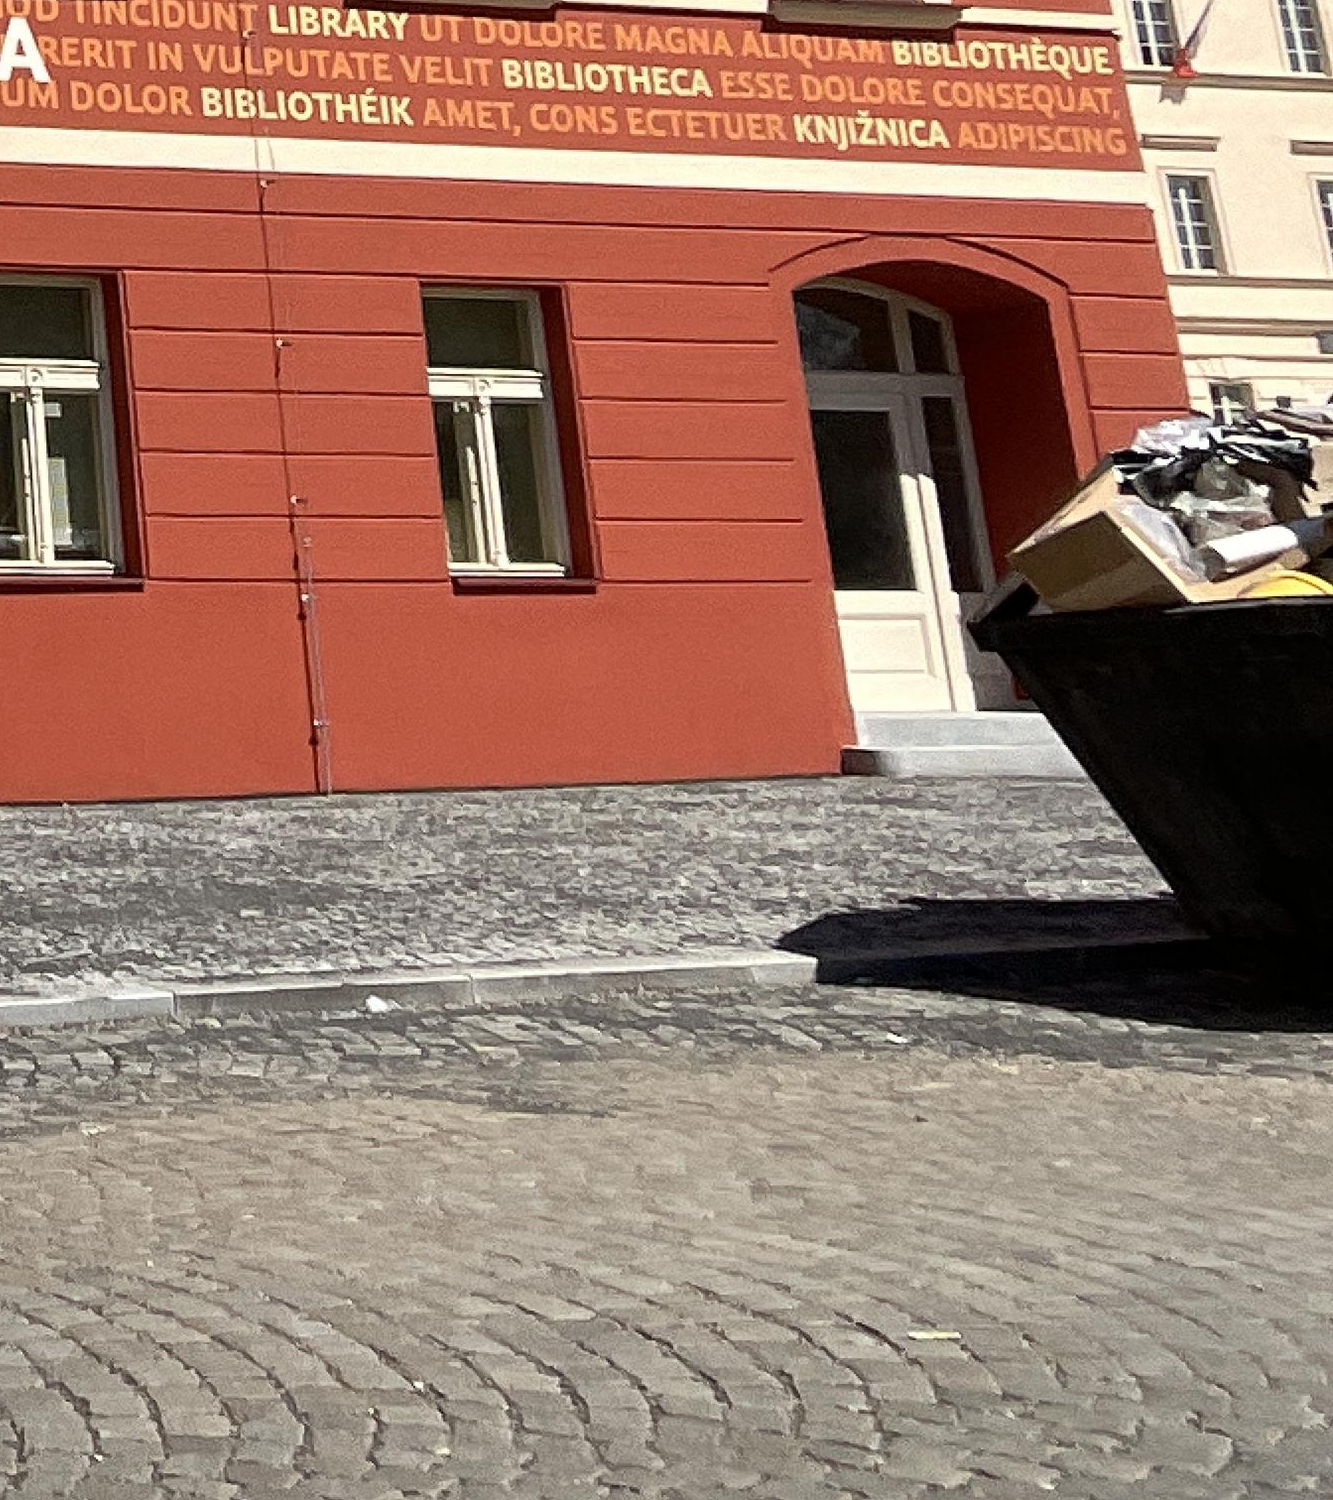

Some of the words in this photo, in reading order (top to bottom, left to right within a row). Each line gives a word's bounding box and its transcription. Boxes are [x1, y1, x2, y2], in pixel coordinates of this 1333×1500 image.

[148, 42, 183, 72] IN
[194, 45, 392, 82] VULPUTATE
[396, 55, 494, 86] VELIT
[501, 58, 713, 98] BIBLIOTHECA
[721, 71, 792, 100] ESSE
[800, 75, 926, 106] DOLORE
[933, 80, 1121, 120] CONSEQUAT,
[268, 4, 409, 41] LIBRARY
[420, 14, 463, 43] UT
[471, 17, 605, 51] DOLORE
[615, 24, 733, 57] MAGNA
[740, 32, 885, 69] ALIQUAM
[892, 37, 1114, 81] BIBLIOTHÈQUE
[71, 81, 192, 115] DOLOR
[201, 86, 413, 125] BIBLIOTHÉIK
[423, 100, 521, 137] AMET,
[531, 103, 617, 135] CONS
[627, 108, 788, 141] ECTETUER
[793, 111, 950, 150] KNJIŽNICA
[958, 121, 1126, 155] ADIPISCING
